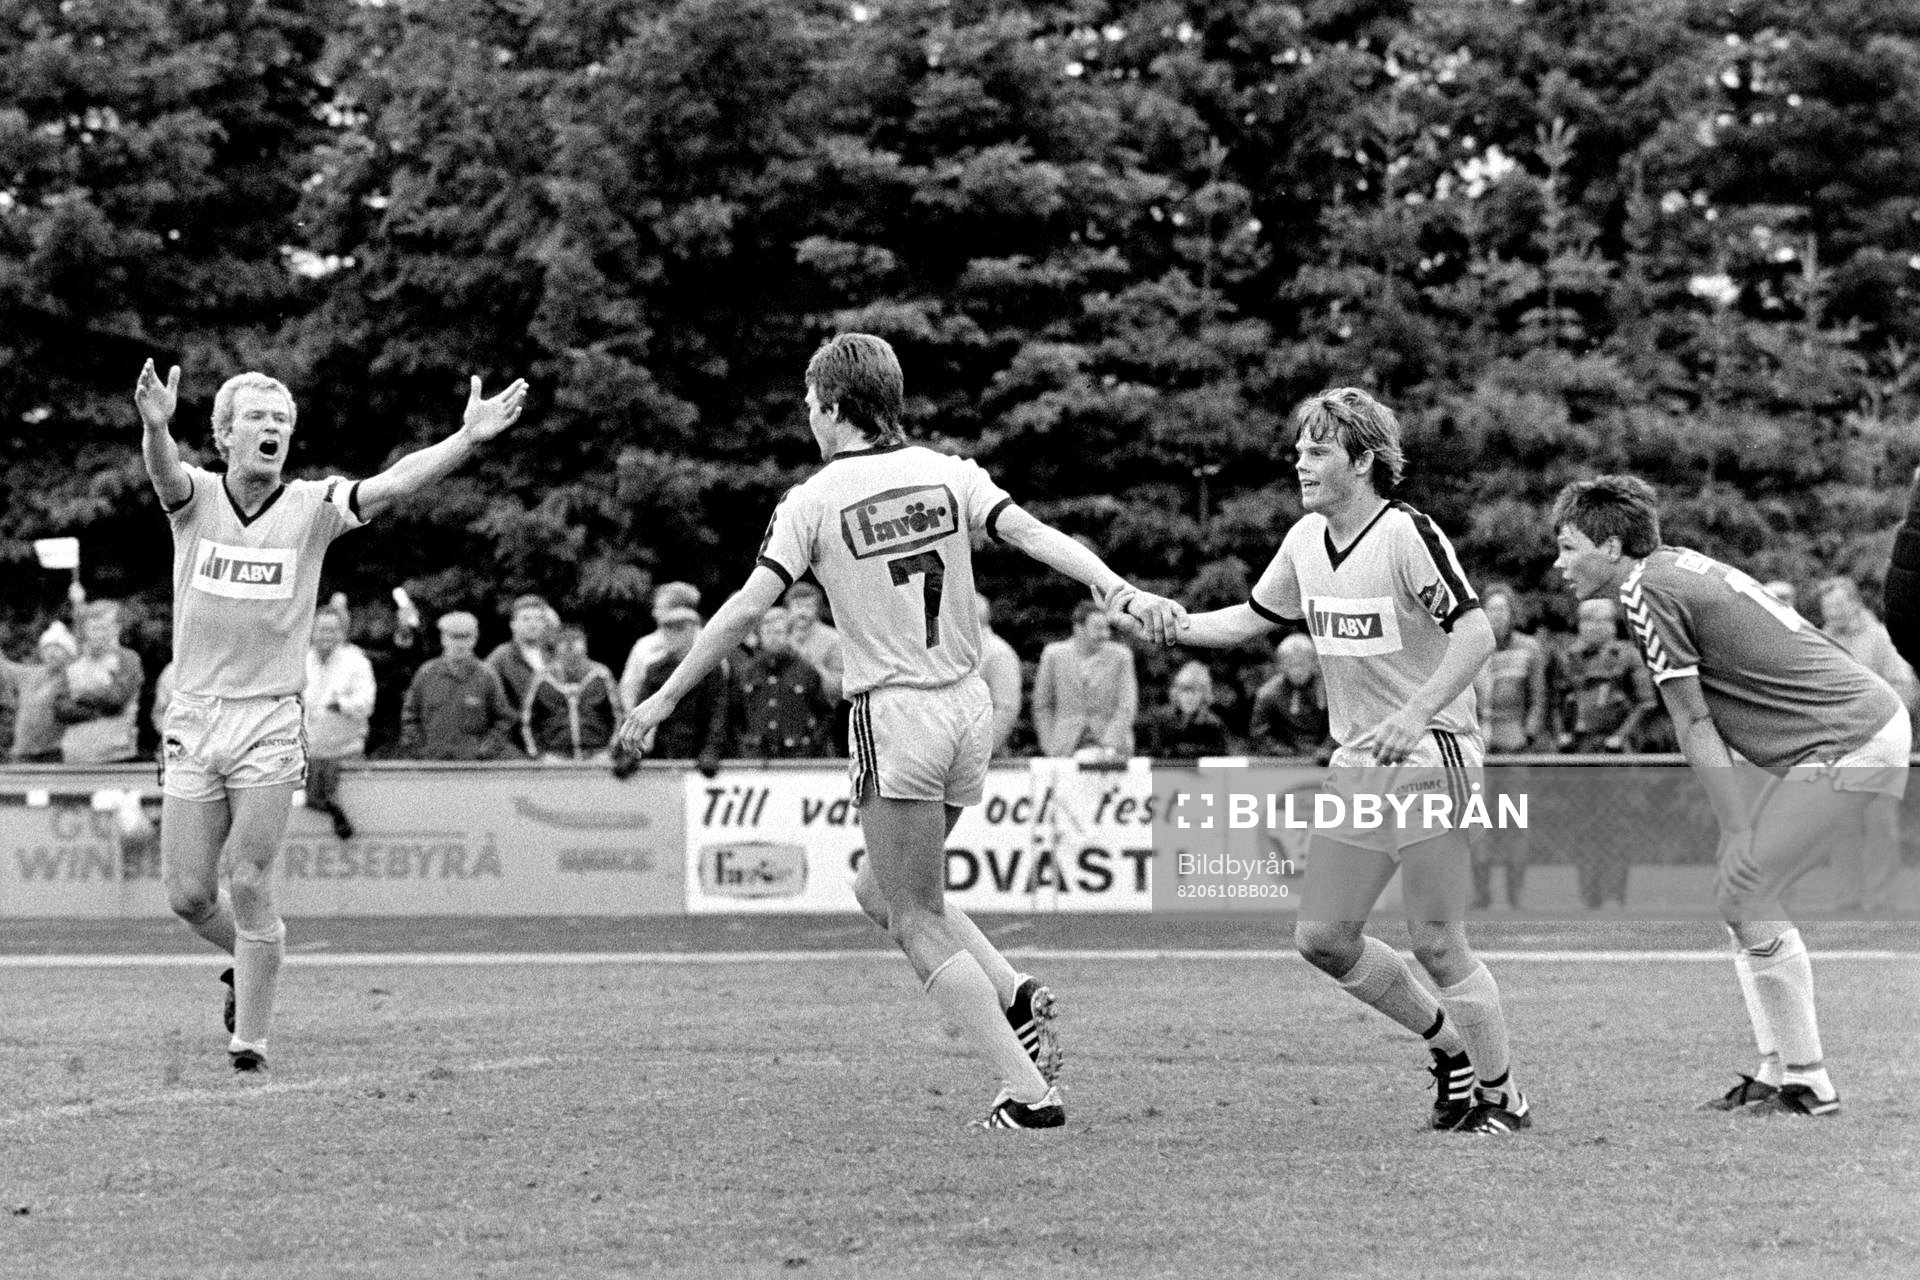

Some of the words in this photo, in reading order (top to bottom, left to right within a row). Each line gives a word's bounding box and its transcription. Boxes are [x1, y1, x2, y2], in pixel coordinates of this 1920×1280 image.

[856, 502, 946, 546] favör
[236, 564, 277, 582] ABV
[887, 549, 945, 650] 7
[1338, 617, 1373, 636] ABV
[704, 784, 770, 826] Till
[285, 831, 503, 879] RESEBYRÅ
